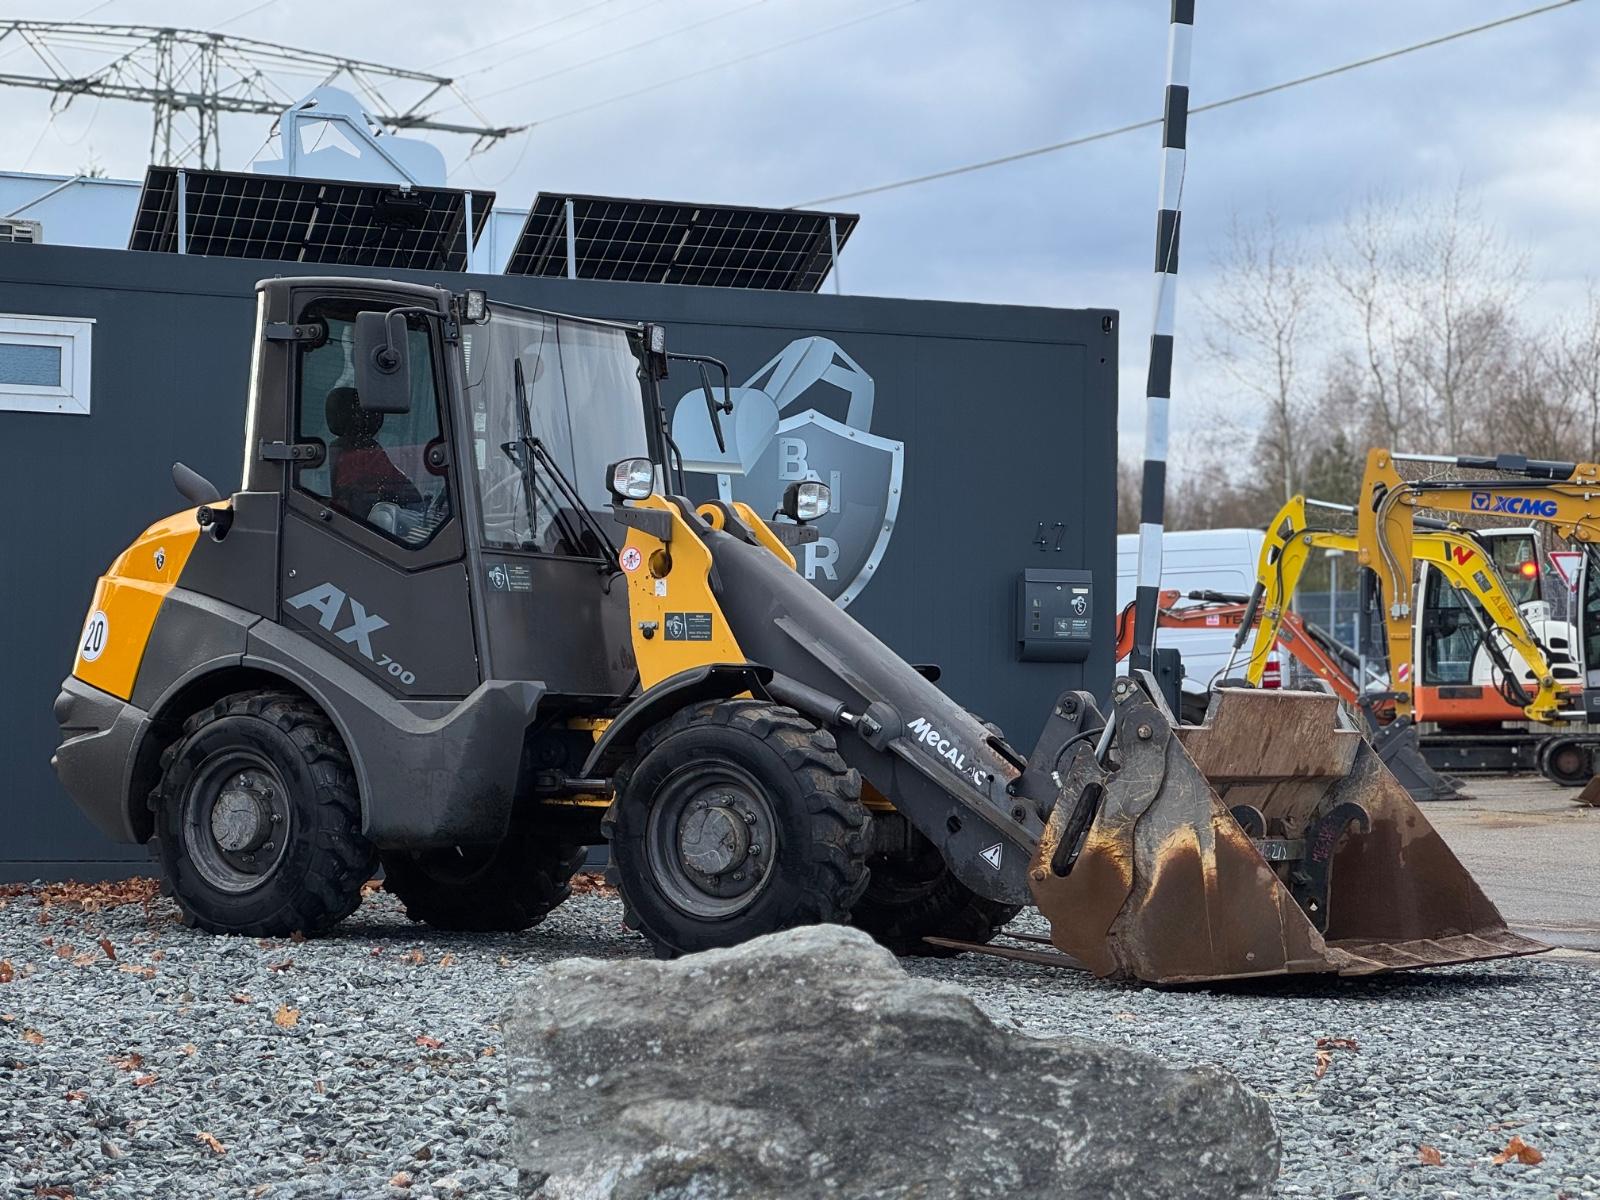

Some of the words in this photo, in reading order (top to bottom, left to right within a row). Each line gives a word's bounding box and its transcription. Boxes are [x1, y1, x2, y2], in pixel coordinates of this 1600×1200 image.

[1493, 496, 1557, 517] XCMG
[84, 621, 104, 652] 20
[286, 582, 390, 661] AX
[376, 654, 416, 684] 700
